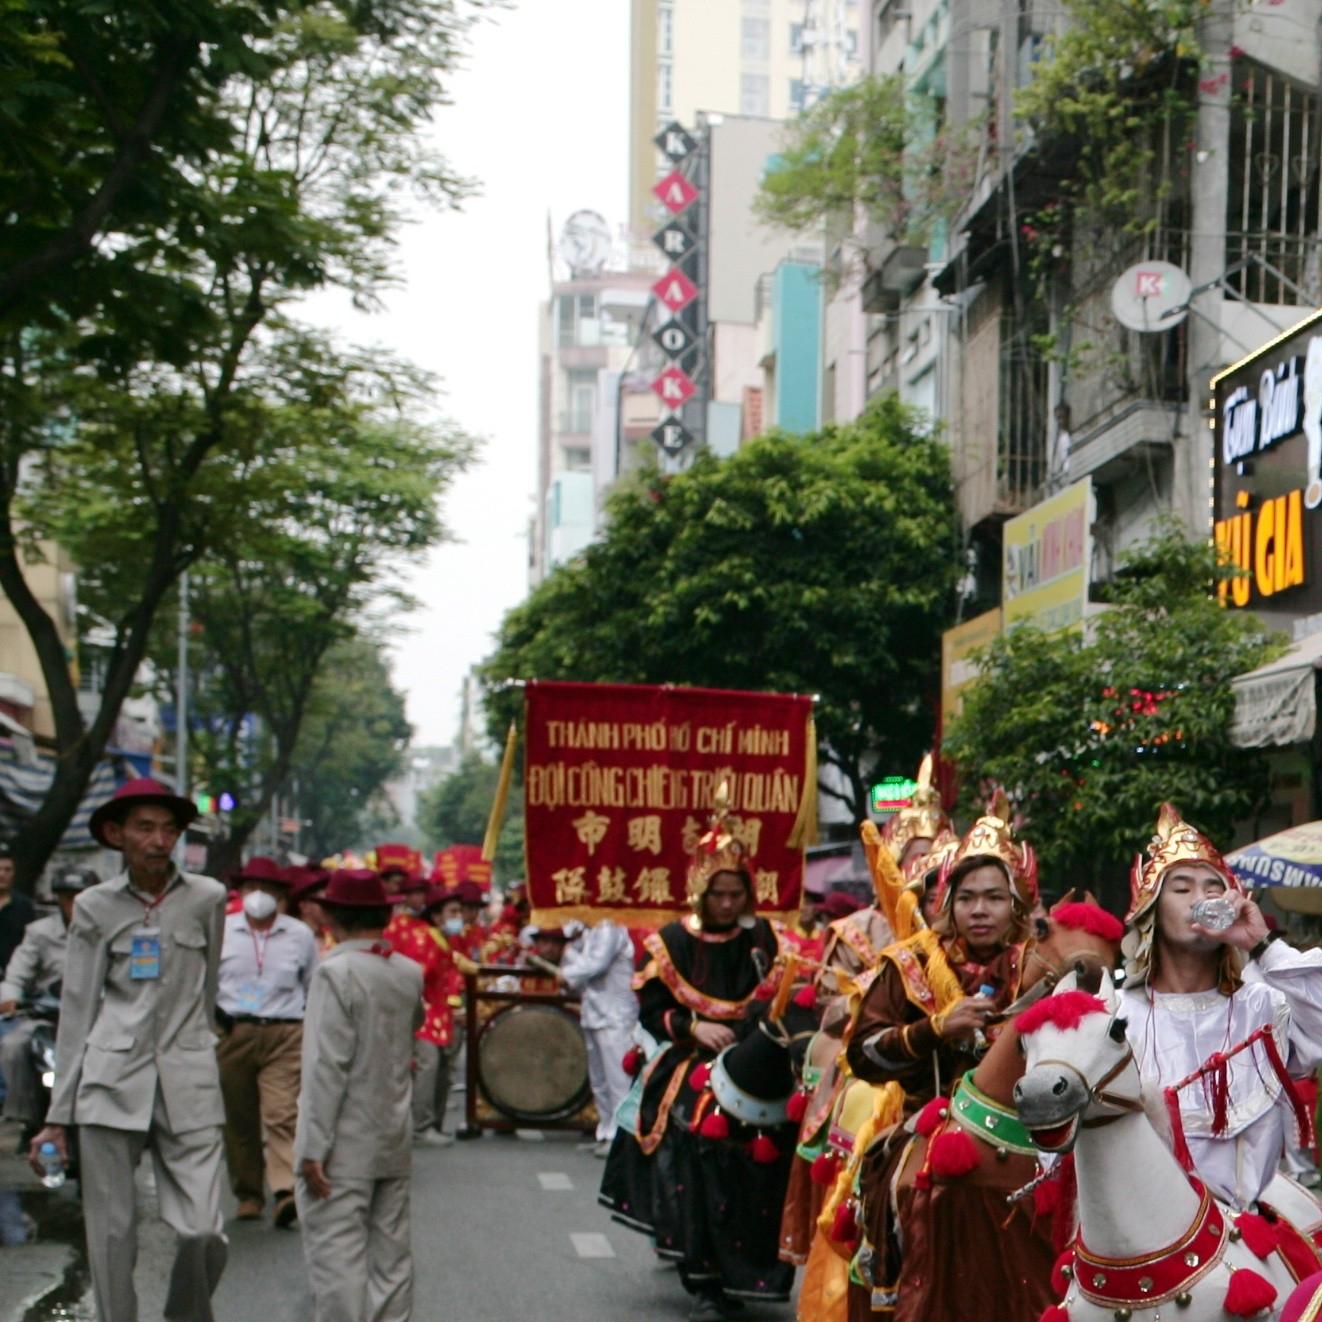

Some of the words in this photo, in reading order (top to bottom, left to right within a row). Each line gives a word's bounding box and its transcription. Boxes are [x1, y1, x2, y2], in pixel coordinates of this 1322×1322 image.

[660, 131, 690, 446] KARAOKE
[1255, 490, 1304, 597] GIA
[697, 720, 737, 755] CHÍ
